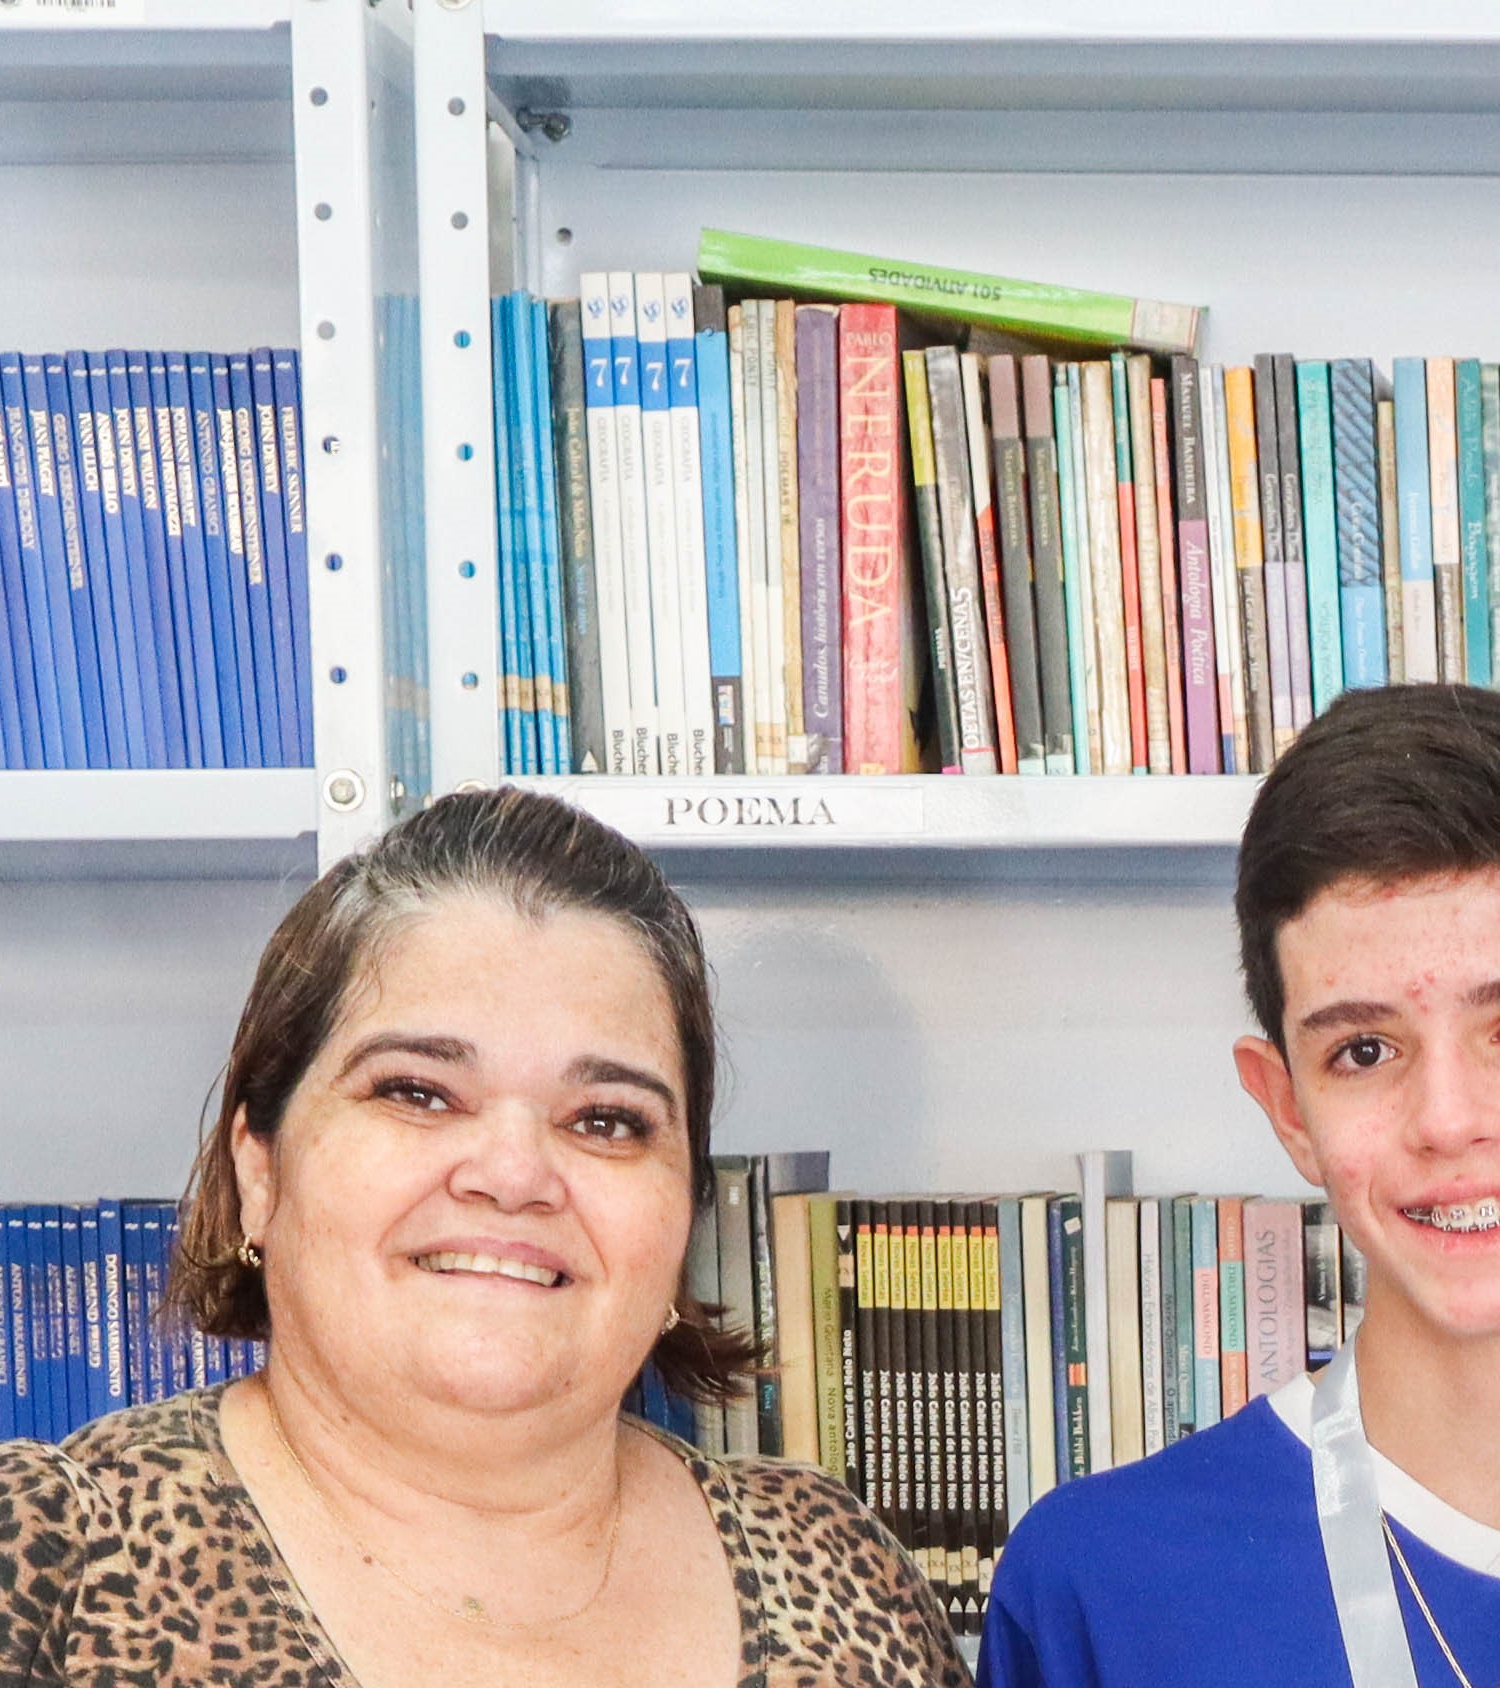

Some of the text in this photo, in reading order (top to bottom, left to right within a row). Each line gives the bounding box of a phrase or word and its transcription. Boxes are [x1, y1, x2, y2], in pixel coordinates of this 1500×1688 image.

[869, 267, 1002, 300] 501 ATIVIDADES
[844, 331, 892, 347] PABLO
[590, 357, 608, 388] 7
[613, 355, 632, 386] 7
[644, 361, 664, 392] 7
[674, 357, 692, 388] 7
[1180, 373, 1196, 504] MANUEL BANDEIRA
[846, 353, 895, 630] NERUDA
[1183, 541, 1209, 685] Antologia Poética
[665, 797, 836, 825] POEMA
[1226, 1266, 1238, 1349] DRUMMOND
[1256, 1229, 1278, 1381] ANTOLOGIAS
[827, 1387, 837, 1420] Nova
[827, 1424, 840, 1477] antologi
[879, 1371, 892, 1508] João Cabral de Melo Neto
[943, 1373, 957, 1510] João Cabral de Melo Neto
[991, 1373, 1004, 1510] João Cabral de Melo Neto
